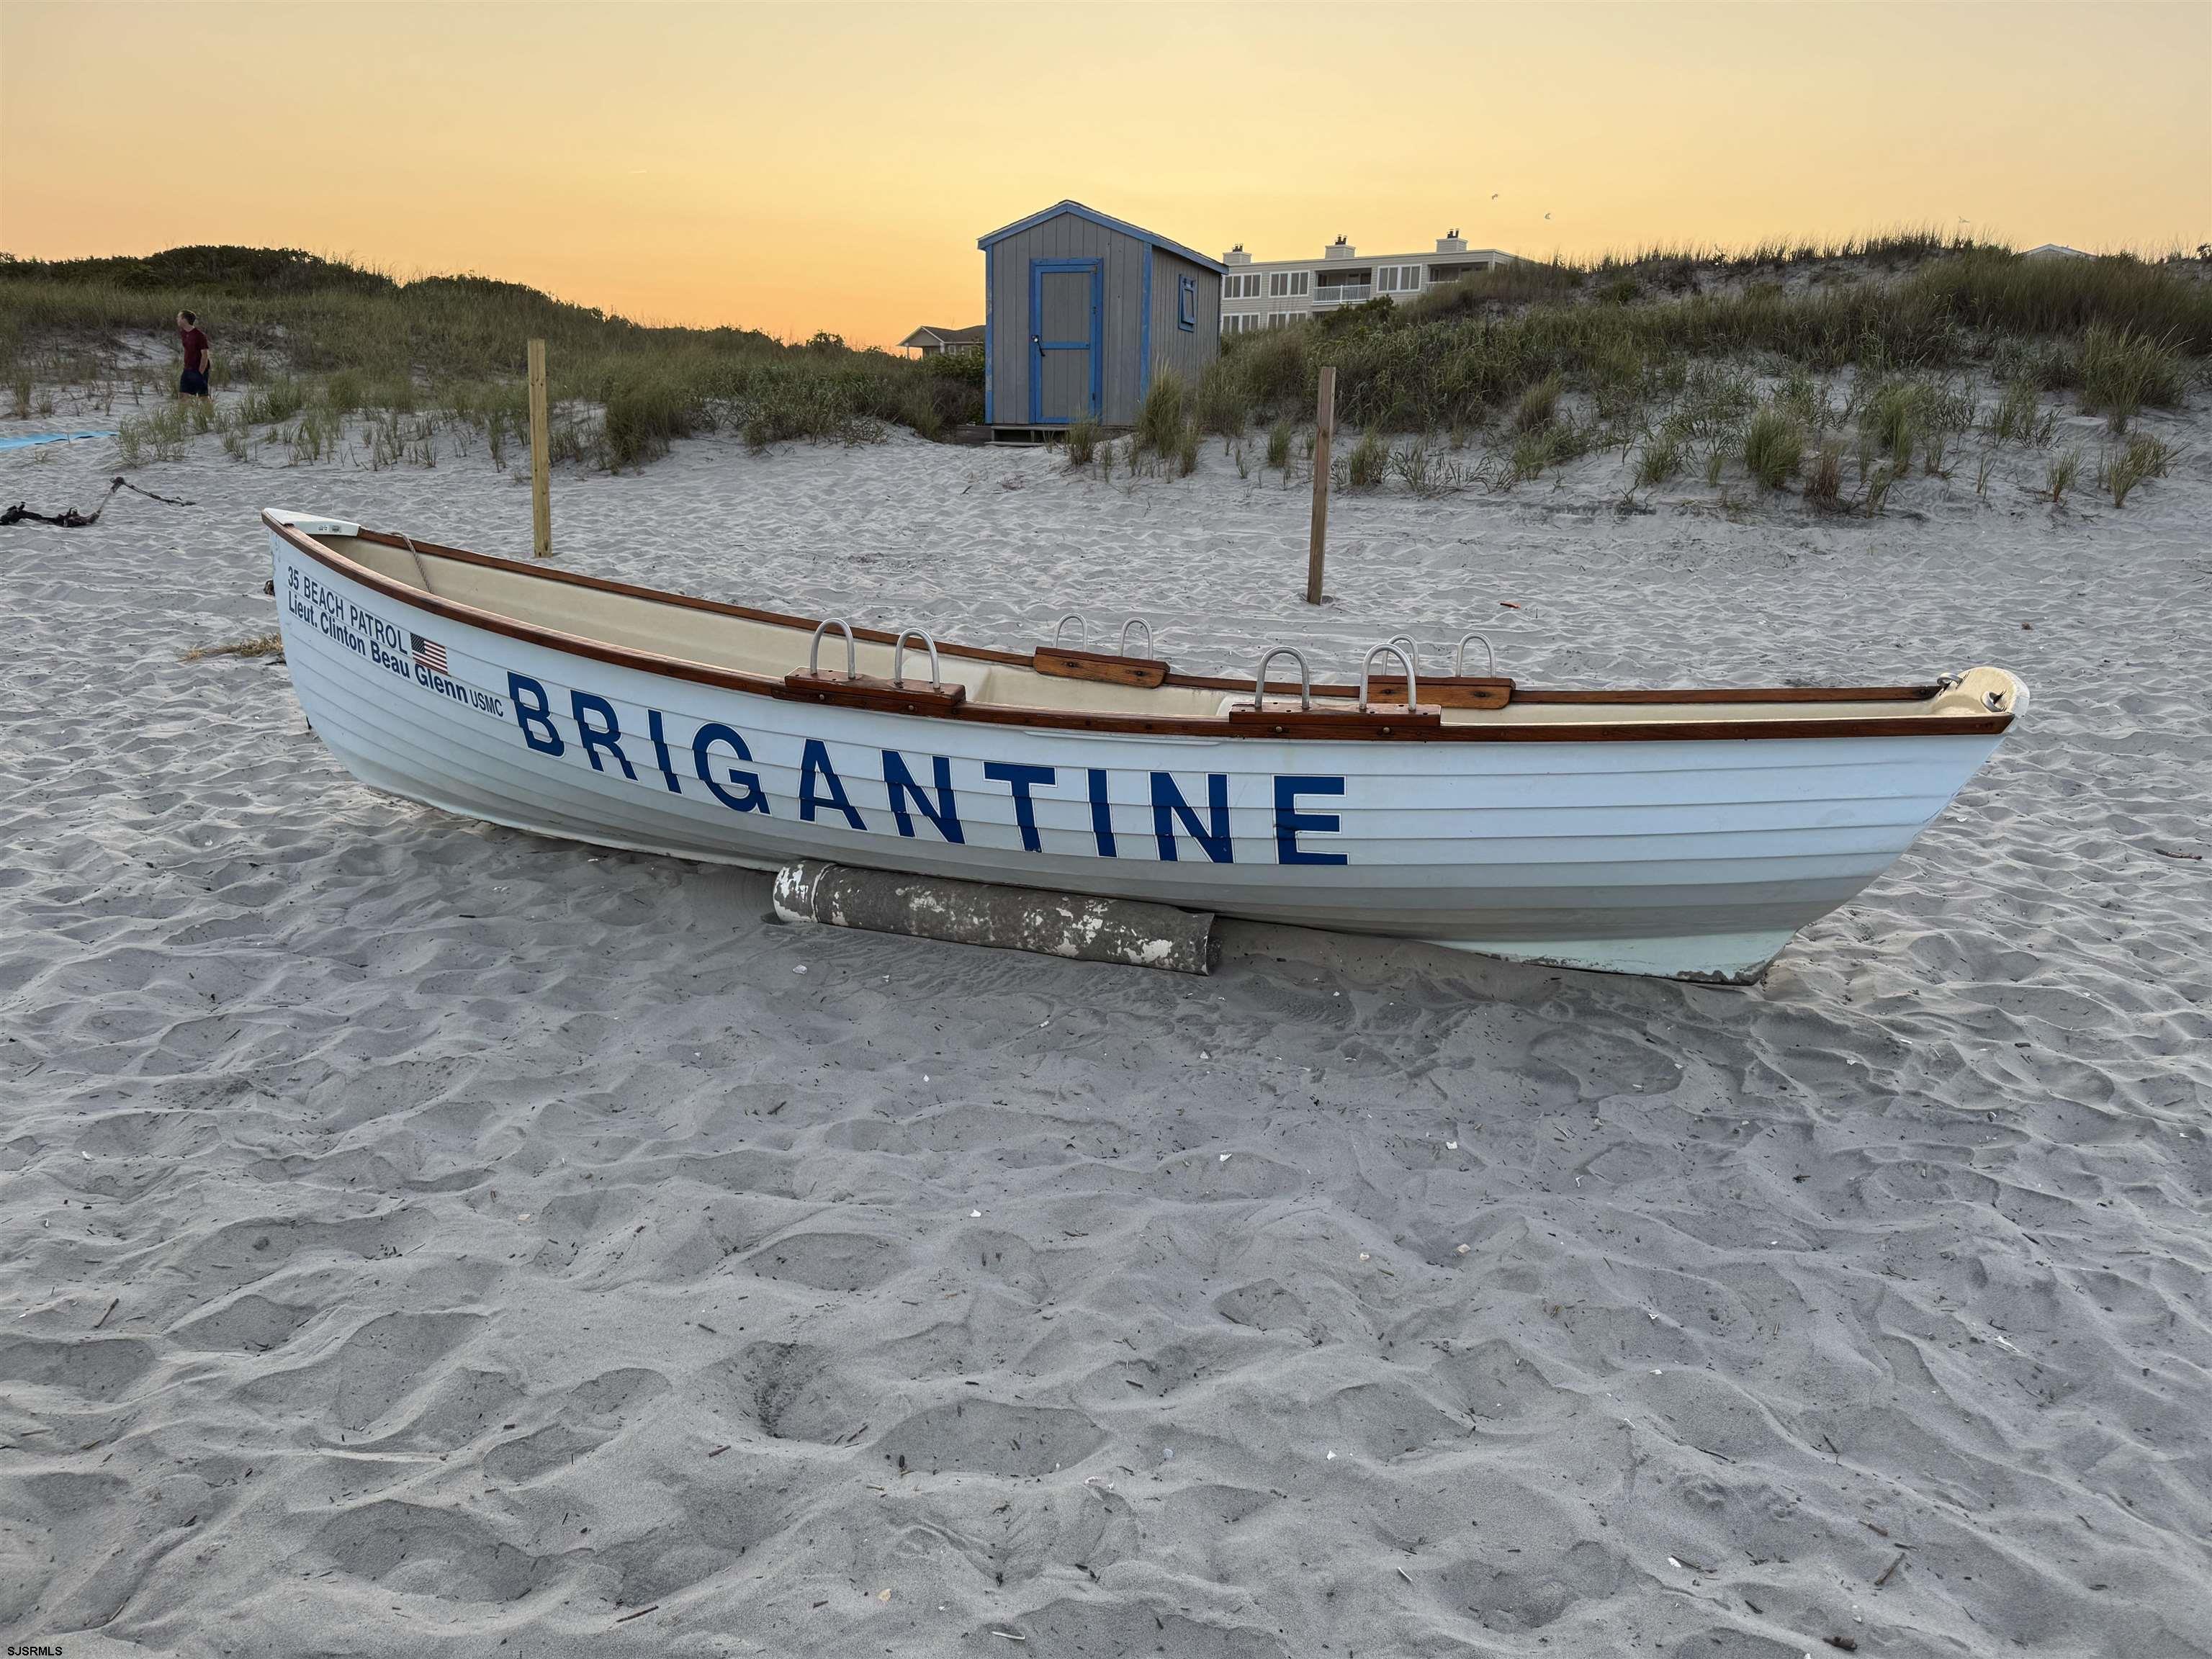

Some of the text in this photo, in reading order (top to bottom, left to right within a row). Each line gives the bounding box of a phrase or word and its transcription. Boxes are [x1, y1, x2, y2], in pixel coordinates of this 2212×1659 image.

[288, 566, 408, 655] 35 BEACH PATROL
[288, 591, 504, 717] Lieut. Clinton Beau Glenn USMC
[506, 670, 1350, 865] BRIGANTINE
